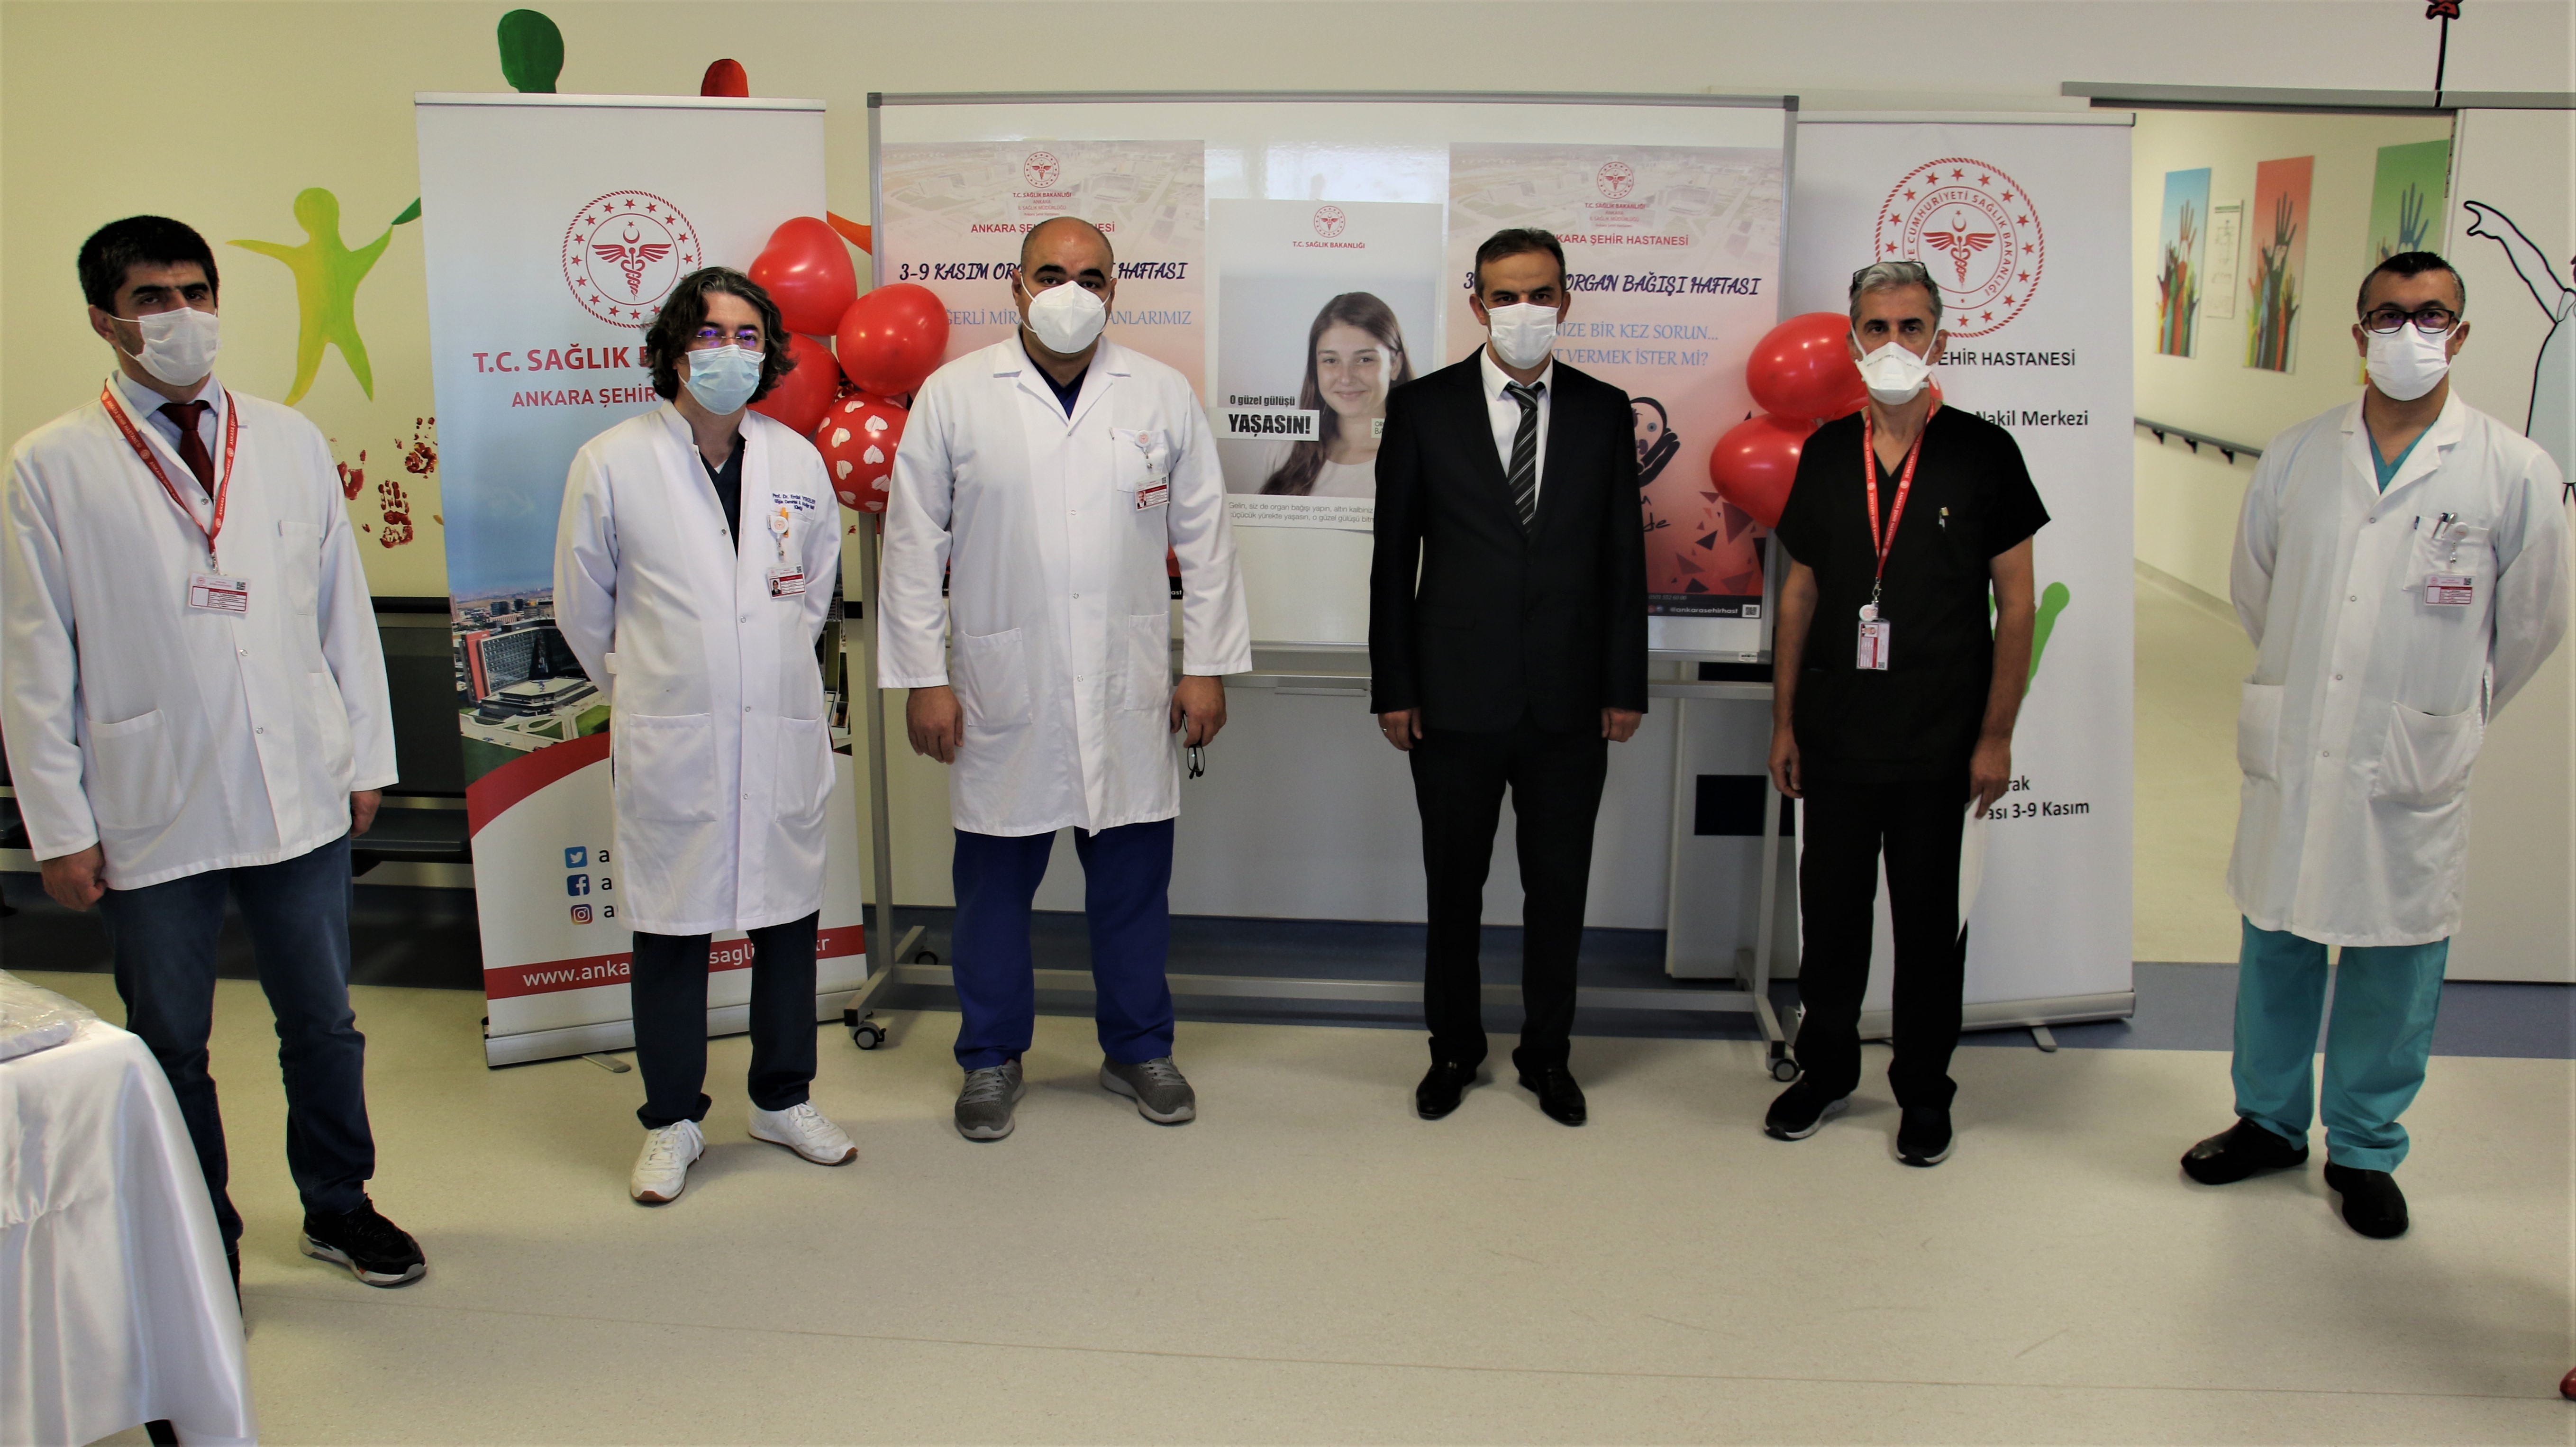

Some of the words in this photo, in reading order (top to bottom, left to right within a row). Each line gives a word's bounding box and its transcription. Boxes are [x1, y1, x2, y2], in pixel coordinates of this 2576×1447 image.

[1972, 195, 2007, 228] SAĞLIK
[971, 224, 1016, 233] ANKARA
[1019, 224, 1035, 235] ŞE
[1556, 234, 1587, 243] KARA
[1590, 233, 1623, 246] ŞEHİR
[1627, 235, 1689, 246] HASTANESİ
[900, 263, 930, 281] 3-9
[934, 263, 990, 281] KASIM
[993, 263, 1021, 280] OR
[1118, 262, 1189, 280] HAFTASI
[1464, 272, 1474, 289] 3
[1622, 271, 1688, 296] BAĞIŞI
[1690, 277, 1762, 295] HAFTASI
[1109, 310, 1192, 325] ANLARIMIZ
[1591, 321, 1616, 338] BİR
[1620, 324, 1649, 339] KEZ
[1653, 324, 1718, 340] SORUN...
[473, 352, 520, 373] T.C.
[528, 343, 630, 371] SAĞLIK
[1553, 348, 1564, 361] T
[1566, 349, 1631, 364] VERMEK
[1636, 348, 1677, 365] İSTER
[1681, 349, 1709, 366] Mİ?
[1939, 348, 1977, 365] EHİR
[1982, 349, 2075, 366] HASTANESİ
[511, 389, 594, 407] ANKARA
[599, 383, 657, 408] ŞEHİR
[1230, 395, 1236, 404] O
[1238, 395, 1262, 406] güzel
[1264, 396, 1295, 408] gülüşü
[1229, 414, 1311, 437] YAŞASIN!
[2022, 410, 2088, 426] Merkezi
[1291, 504, 1311, 512] bağışı
[2007, 775, 2030, 792] rak
[2012, 802, 2037, 819] 3-9
[2042, 801, 2090, 816] Kasım
[599, 850, 610, 863] a
[601, 877, 612, 891] a
[523, 960, 631, 987] www.anka
